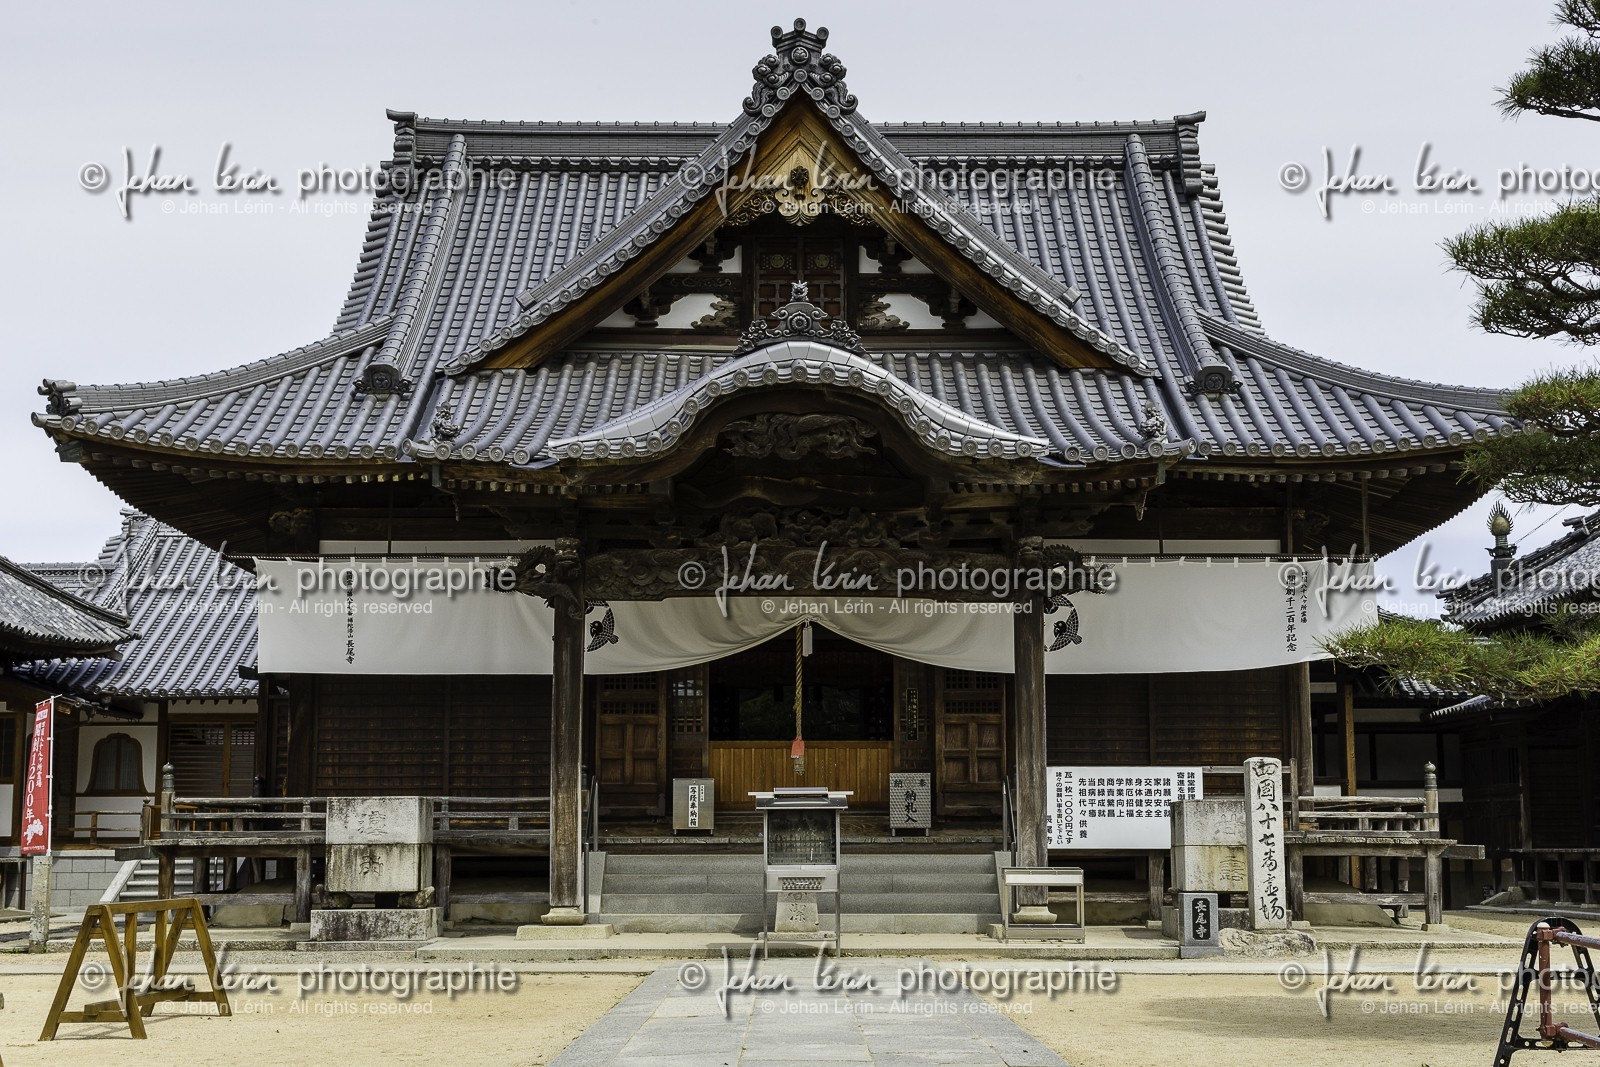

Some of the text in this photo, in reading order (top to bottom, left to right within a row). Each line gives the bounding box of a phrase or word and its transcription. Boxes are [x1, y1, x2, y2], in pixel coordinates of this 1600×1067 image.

[1079, 777, 1088, 839] 先祖代々供養
[1088, 777, 1097, 818] 当病平癒
[1097, 777, 1107, 818] 良縁成就
[1116, 777, 1125, 818] 学業向上
[1125, 777, 1135, 818] 除厄招福
[1135, 777, 1144, 818] 身体健全
[1144, 777, 1153, 818] 交通安全
[1154, 777, 1162, 818] 家内安全
[1195, 900, 1208, 938] 長尾寺
